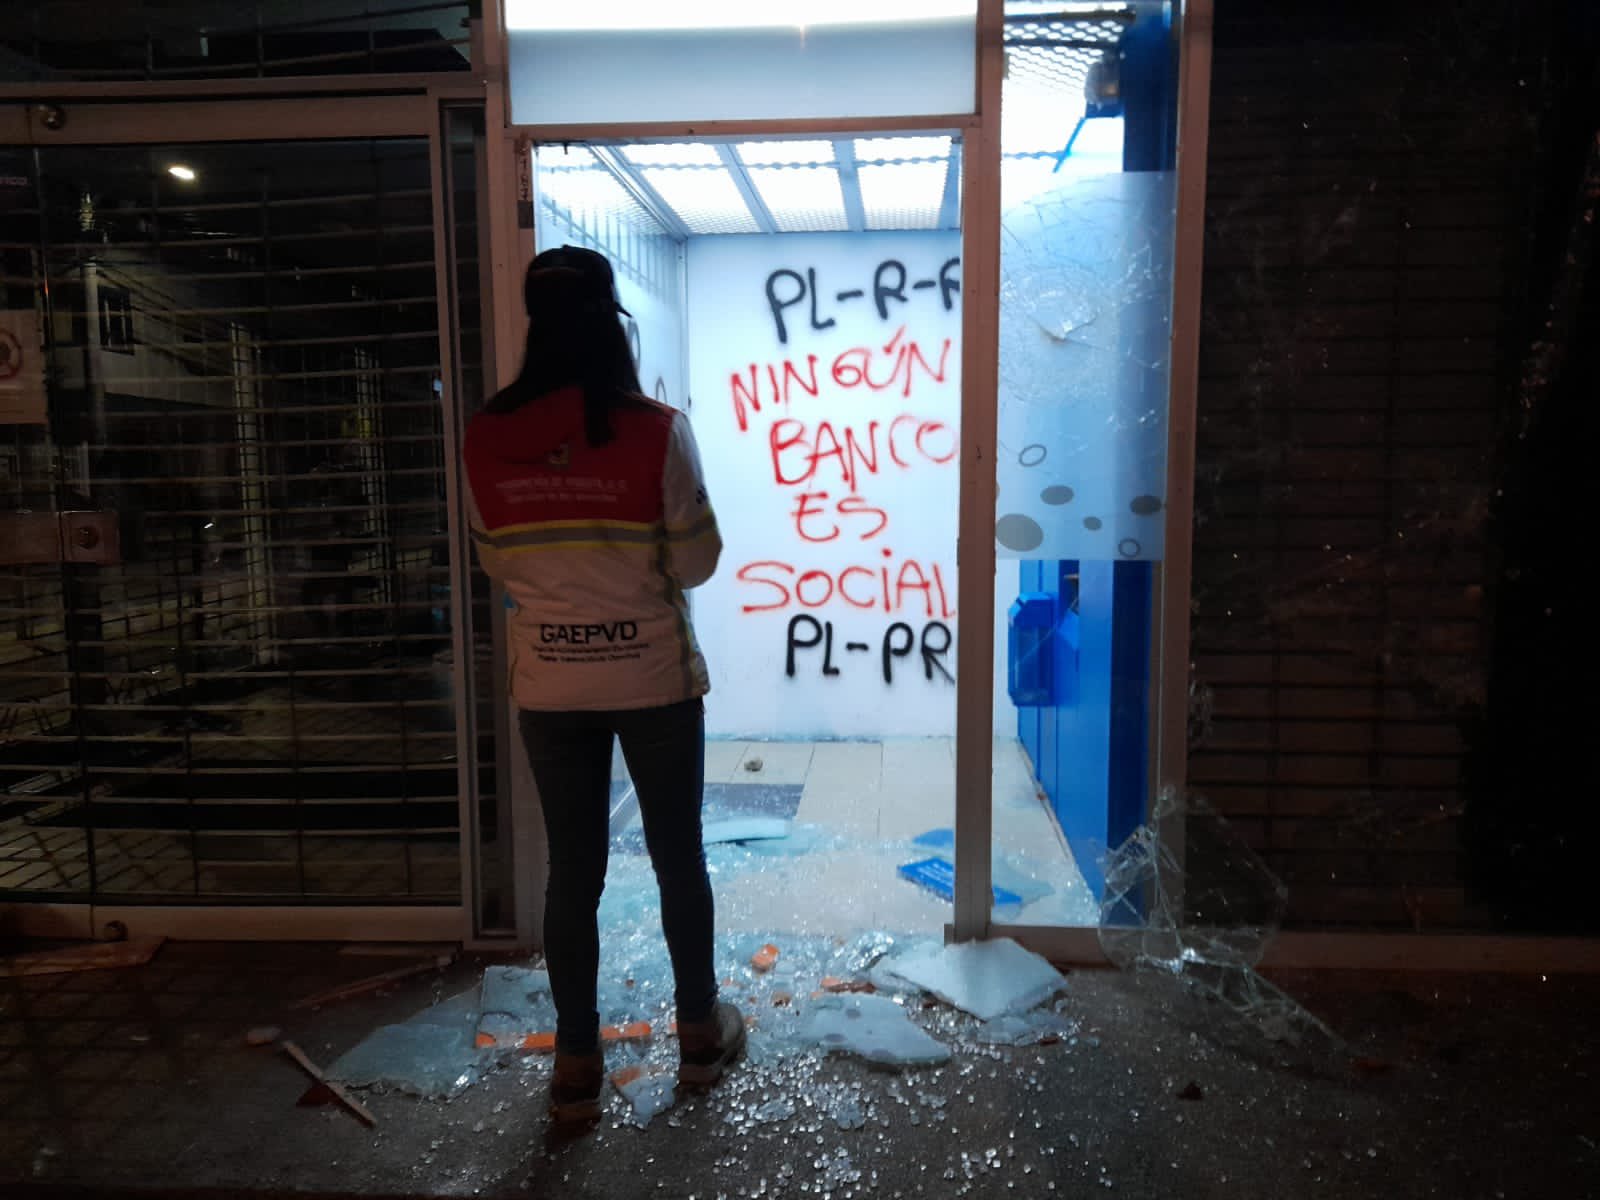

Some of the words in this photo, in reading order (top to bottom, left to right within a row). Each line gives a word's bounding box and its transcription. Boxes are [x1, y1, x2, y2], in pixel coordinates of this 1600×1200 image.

[769, 414, 959, 492] BANCO
[790, 491, 888, 542] ES
[540, 621, 637, 644] GAEPVD
